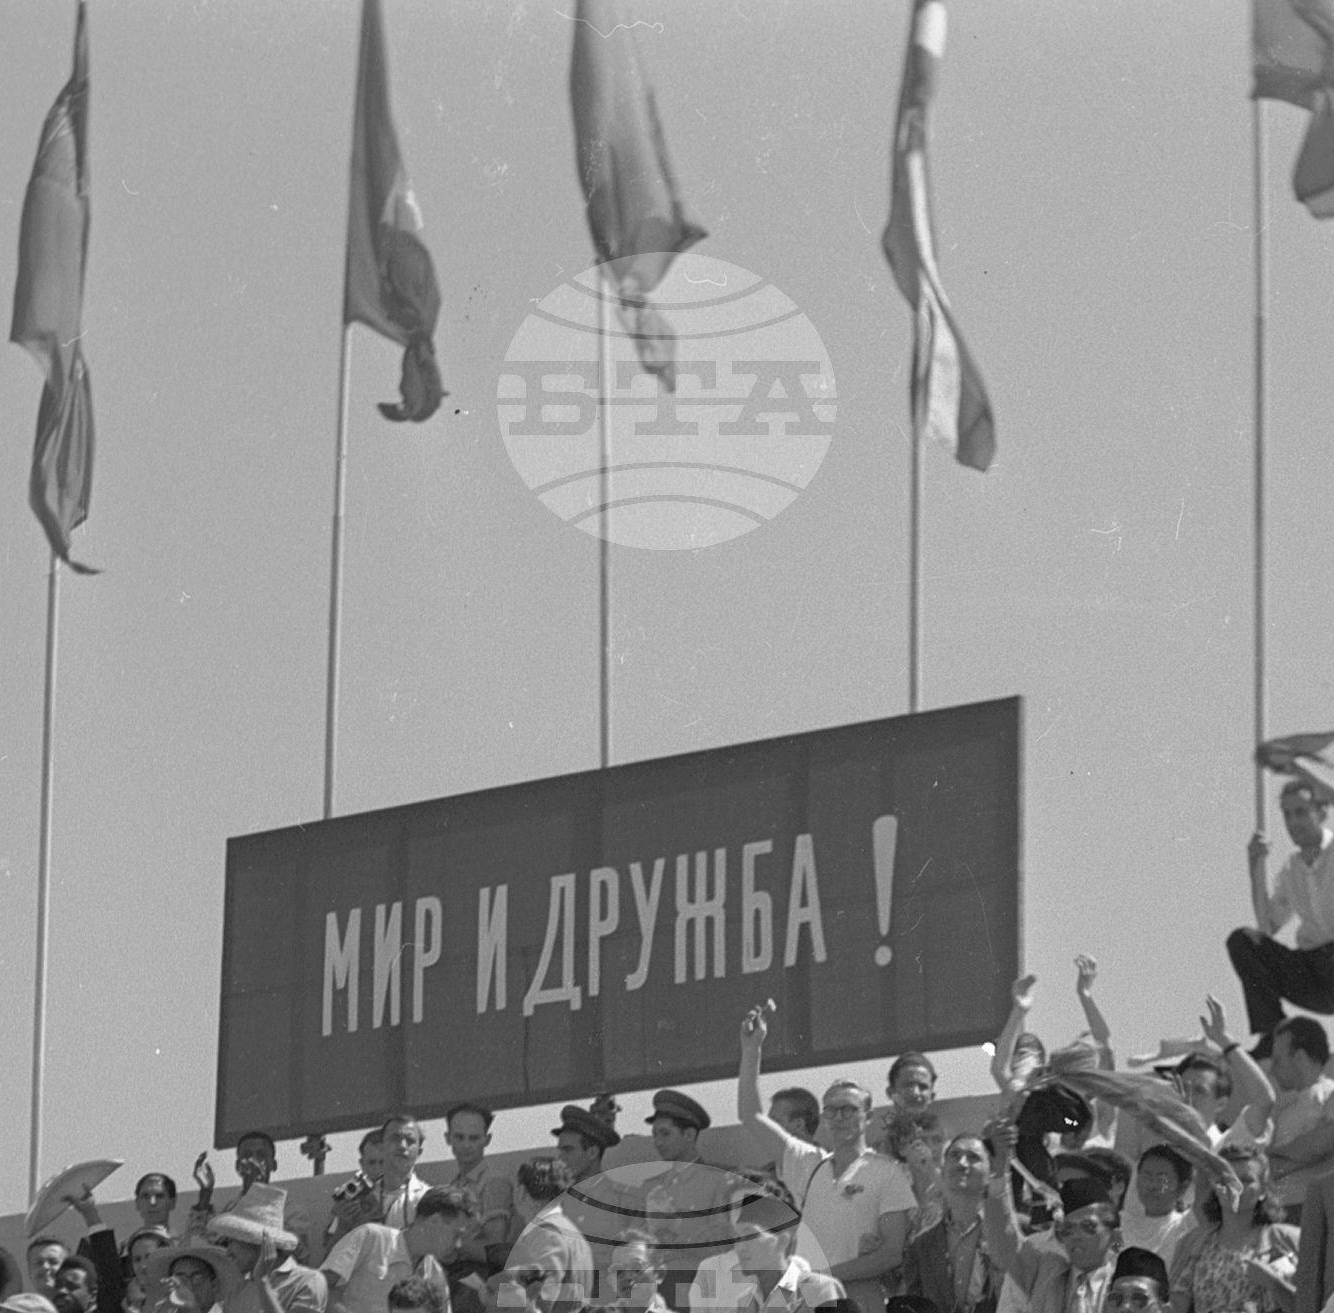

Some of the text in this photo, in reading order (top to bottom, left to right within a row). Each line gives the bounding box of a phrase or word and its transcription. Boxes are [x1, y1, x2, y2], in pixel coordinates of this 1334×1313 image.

[322, 897, 443, 1037] МИР
[477, 884, 508, 1015] И
[523, 833, 828, 1017] ДРУЖБА
